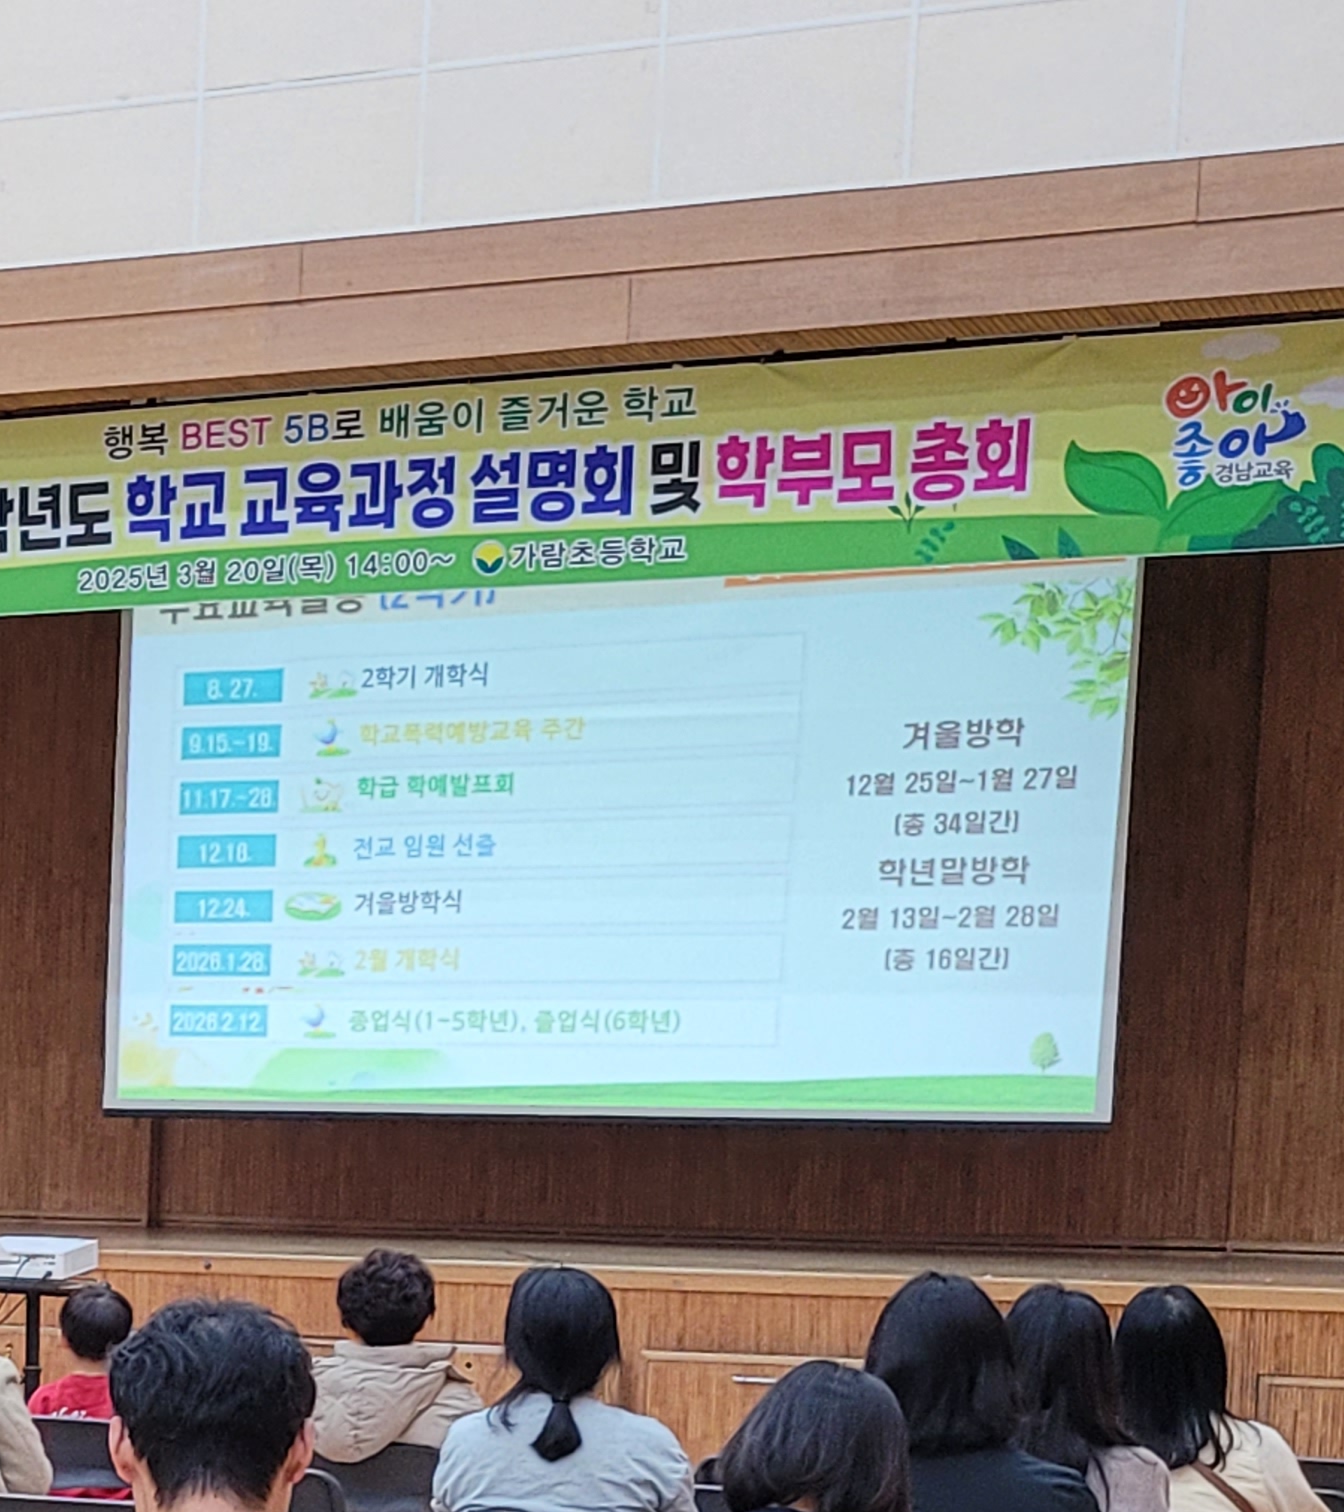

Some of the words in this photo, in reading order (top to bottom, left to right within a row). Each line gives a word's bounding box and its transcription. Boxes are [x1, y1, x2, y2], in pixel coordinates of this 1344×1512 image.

[104, 423, 169, 460] 행복
[180, 416, 272, 450] BEST
[284, 409, 365, 444] 5B로
[379, 397, 483, 438] 배움이
[498, 390, 608, 432] 즐거운
[623, 386, 697, 422] 학교
[127, 471, 226, 542] 학교
[240, 455, 456, 536] 교육과정
[470, 444, 635, 524] 설명회
[651, 440, 701, 516] 및
[717, 429, 894, 508] 학부모
[911, 418, 1031, 501] 총회
[1215, 460, 1294, 483] 경남교육
[513, 536, 686, 570] 가람초등학교
[79, 563, 168, 591] 2025년
[179, 559, 216, 586] 3월
[227, 553, 335, 583] 20일(목)
[347, 550, 454, 577] 14:00~
[361, 665, 416, 690] 2학기
[424, 662, 489, 688] 개학식
[541, 717, 586, 741] 주간
[902, 717, 1025, 750] 겨울방학
[358, 775, 399, 800] 학급
[847, 772, 895, 797] 12월
[905, 768, 1014, 795] 25일~1월
[1023, 765, 1078, 790] 27일
[934, 810, 1019, 835] 34일간)
[353, 836, 396, 860] 전교
[404, 833, 445, 859] 임원
[878, 856, 1030, 888] 학년말방학
[354, 889, 462, 916] 겨울방학식
[841, 907, 879, 931] 2월
[890, 904, 996, 930] 13일~2월
[1005, 903, 1059, 929] 28일
[926, 947, 1009, 971] 16일간)
